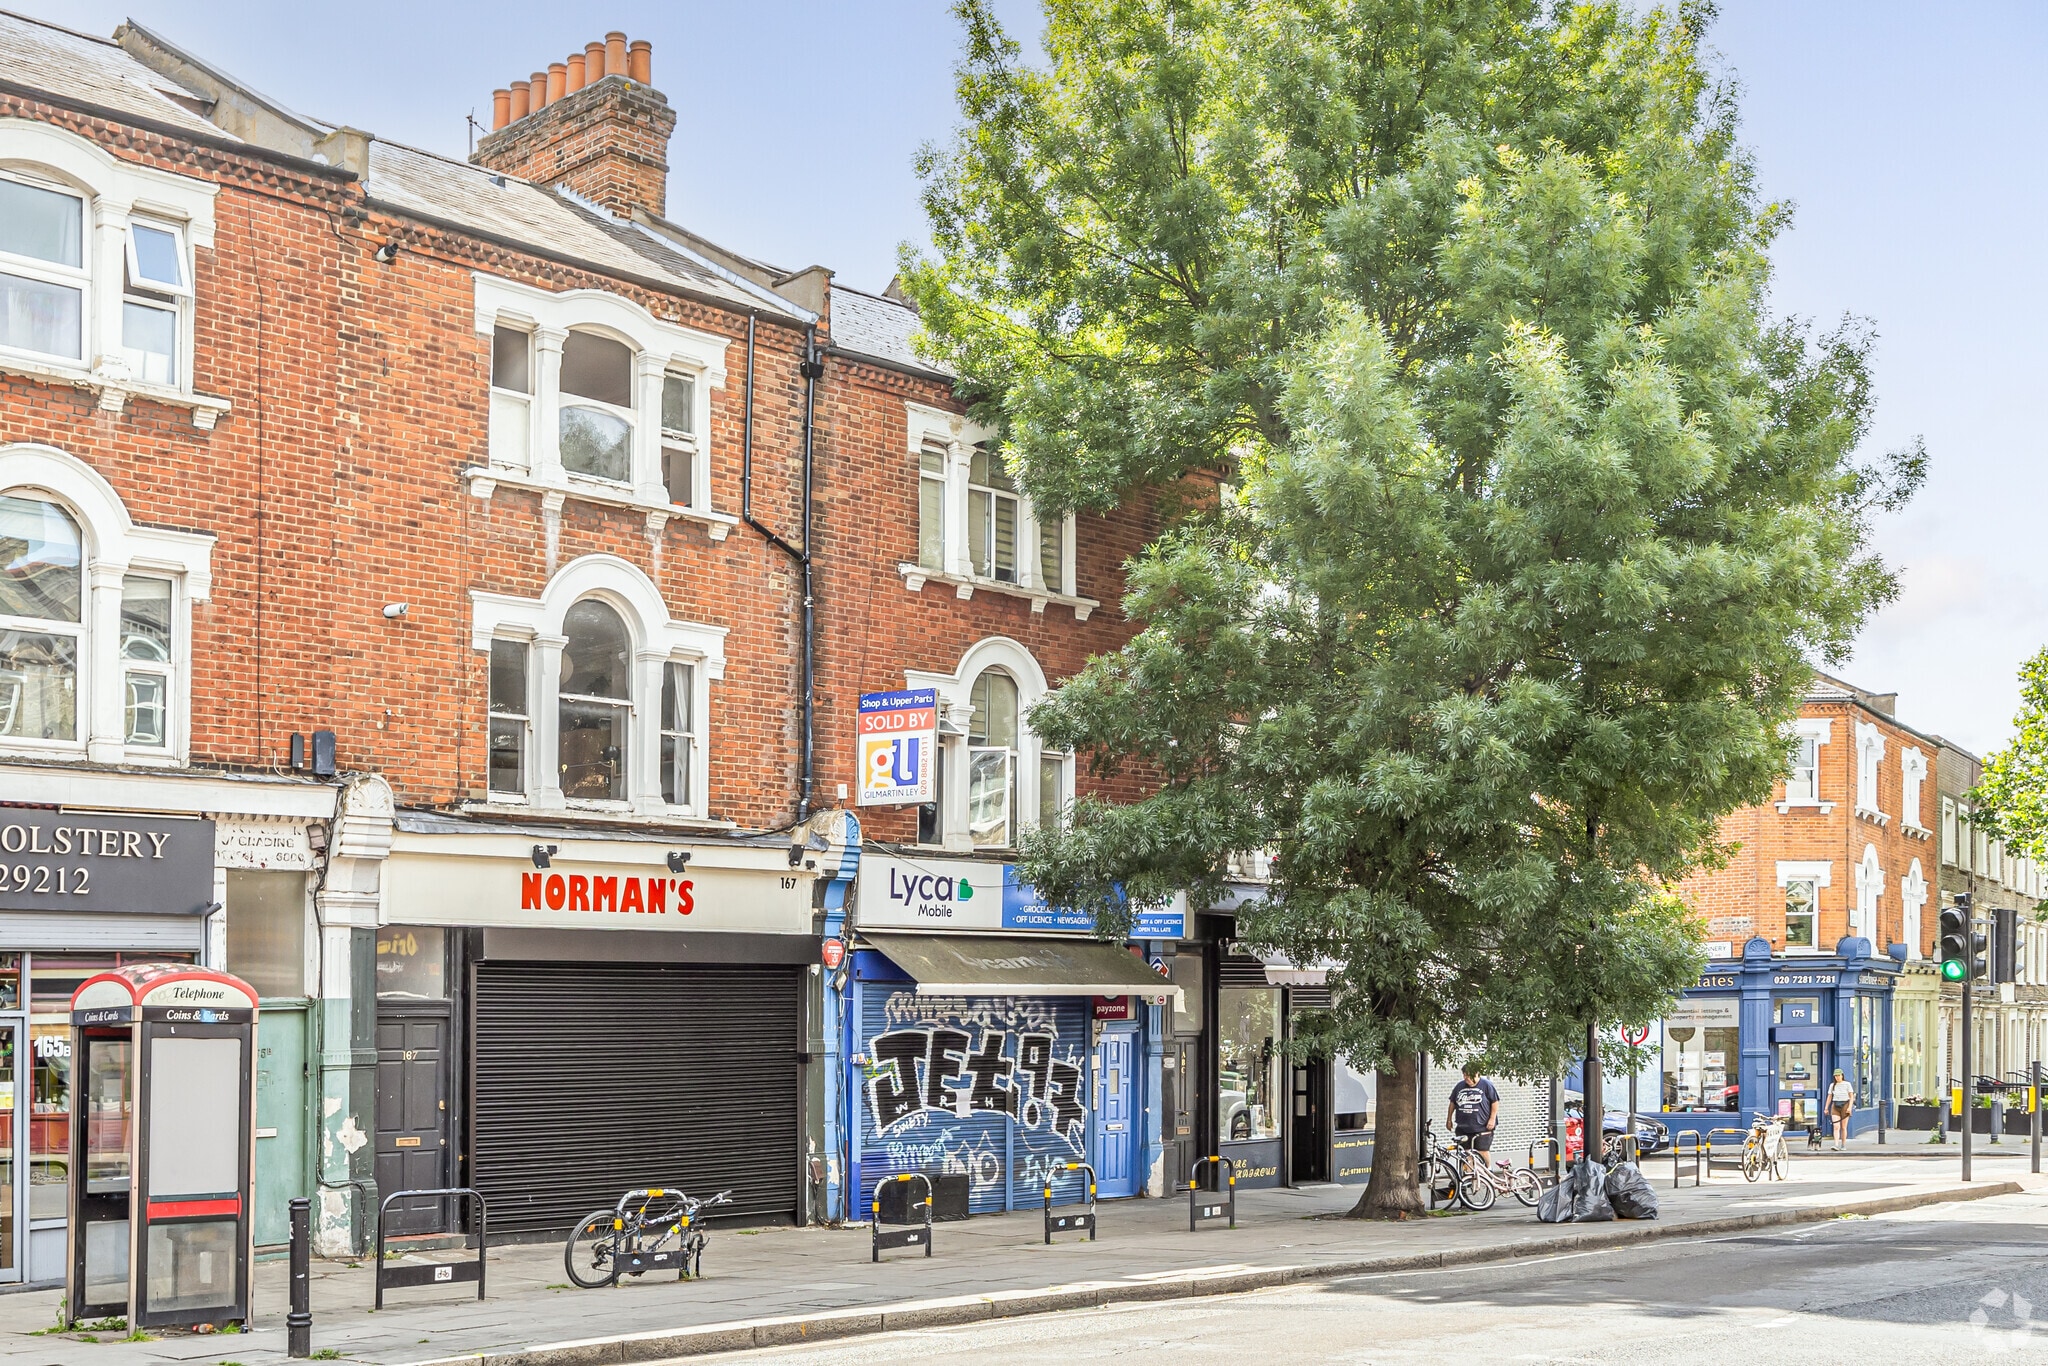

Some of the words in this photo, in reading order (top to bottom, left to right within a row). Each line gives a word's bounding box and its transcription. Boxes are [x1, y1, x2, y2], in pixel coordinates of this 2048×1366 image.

[861, 699, 881, 710] Shop
[881, 698, 889, 707] &
[890, 697, 913, 708] Upper
[914, 695, 933, 704] Parts
[865, 714, 905, 731] SOLD
[908, 712, 929, 728] BY
[864, 789, 904, 799] GILMARTIN
[905, 788, 919, 797] LEY
[920, 780, 928, 796] 020
[780, 877, 797, 890] 167
[890, 867, 954, 906] Lyca
[521, 872, 695, 916] NORMAN'S
[918, 904, 953, 918] Mobile
[1016, 915, 1028, 924] OFF
[1029, 916, 1053, 924] LICENCE
[1774, 976, 1790, 985] 020
[1792, 975, 1812, 984] 7281
[1815, 975, 1836, 984] 7281
[173, 987, 225, 1001] Telephone
[166, 1009, 192, 1020] Coins
[192, 1010, 201, 1021] &
[1096, 1005, 1126, 1015] payzone
[1791, 1009, 1806, 1018] 175
[402, 1050, 419, 1060] 167
